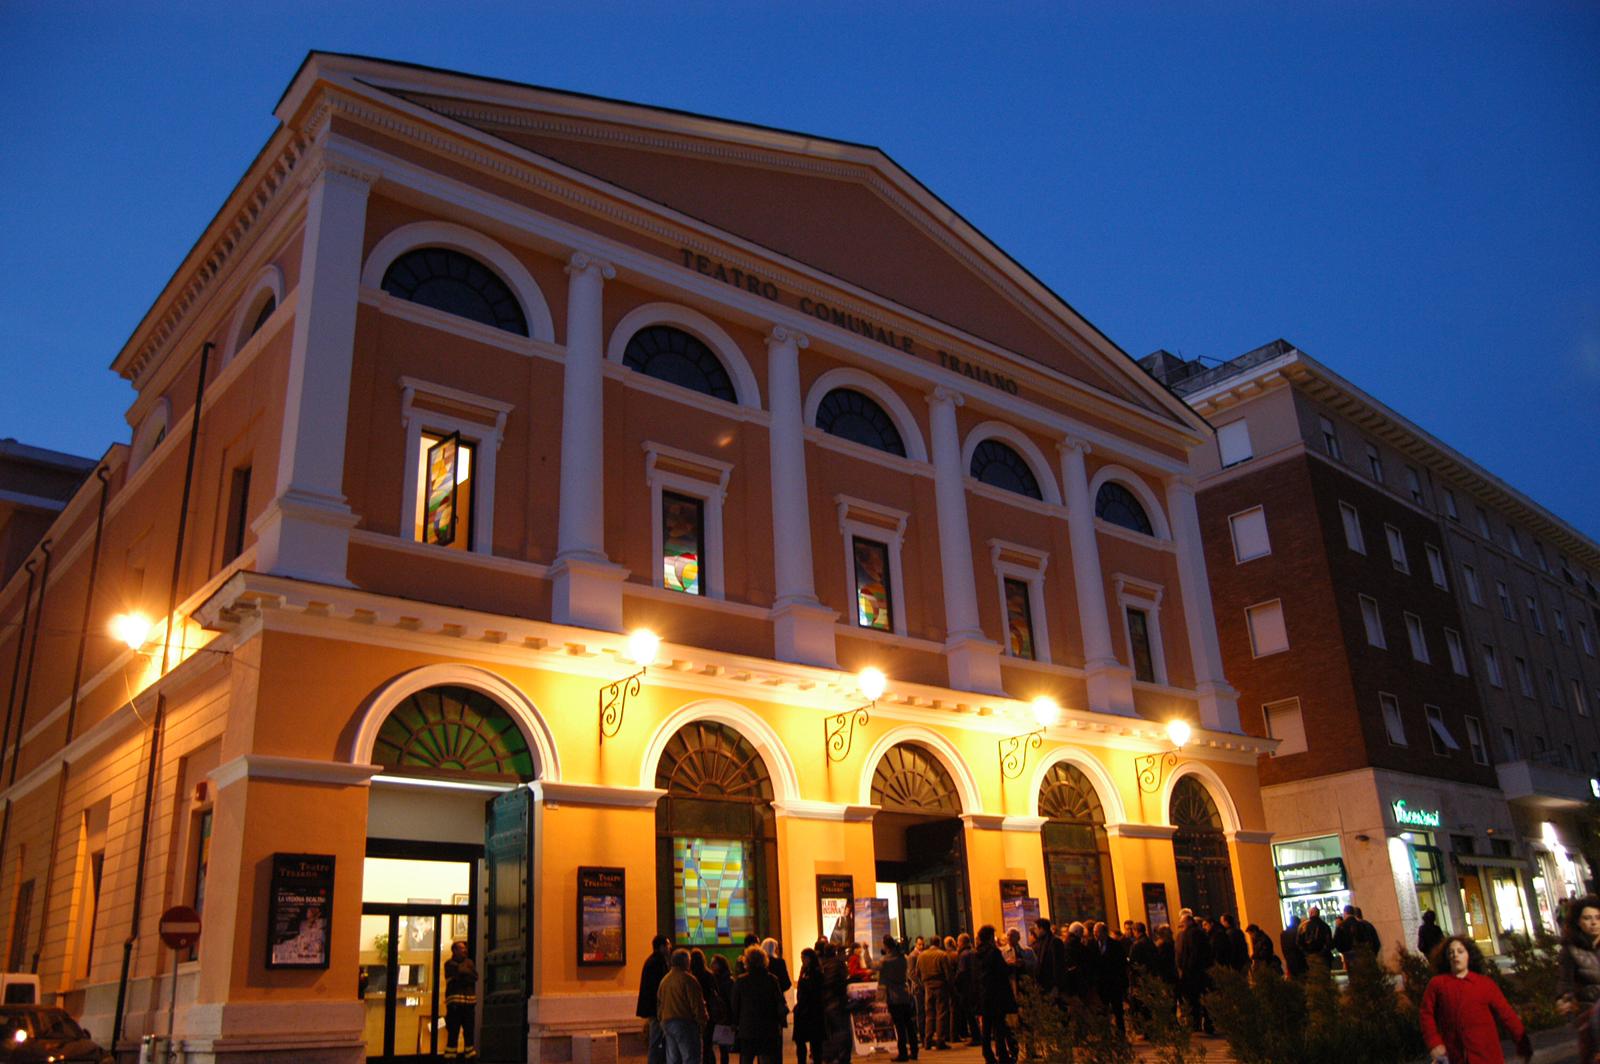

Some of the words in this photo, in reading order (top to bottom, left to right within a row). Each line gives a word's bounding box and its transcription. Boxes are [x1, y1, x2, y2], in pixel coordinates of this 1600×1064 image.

[680, 248, 779, 301] TEATRO
[800, 297, 915, 354] COMUNALE
[938, 350, 1018, 395] TRAIANO
[298, 862, 330, 872] Teatro
